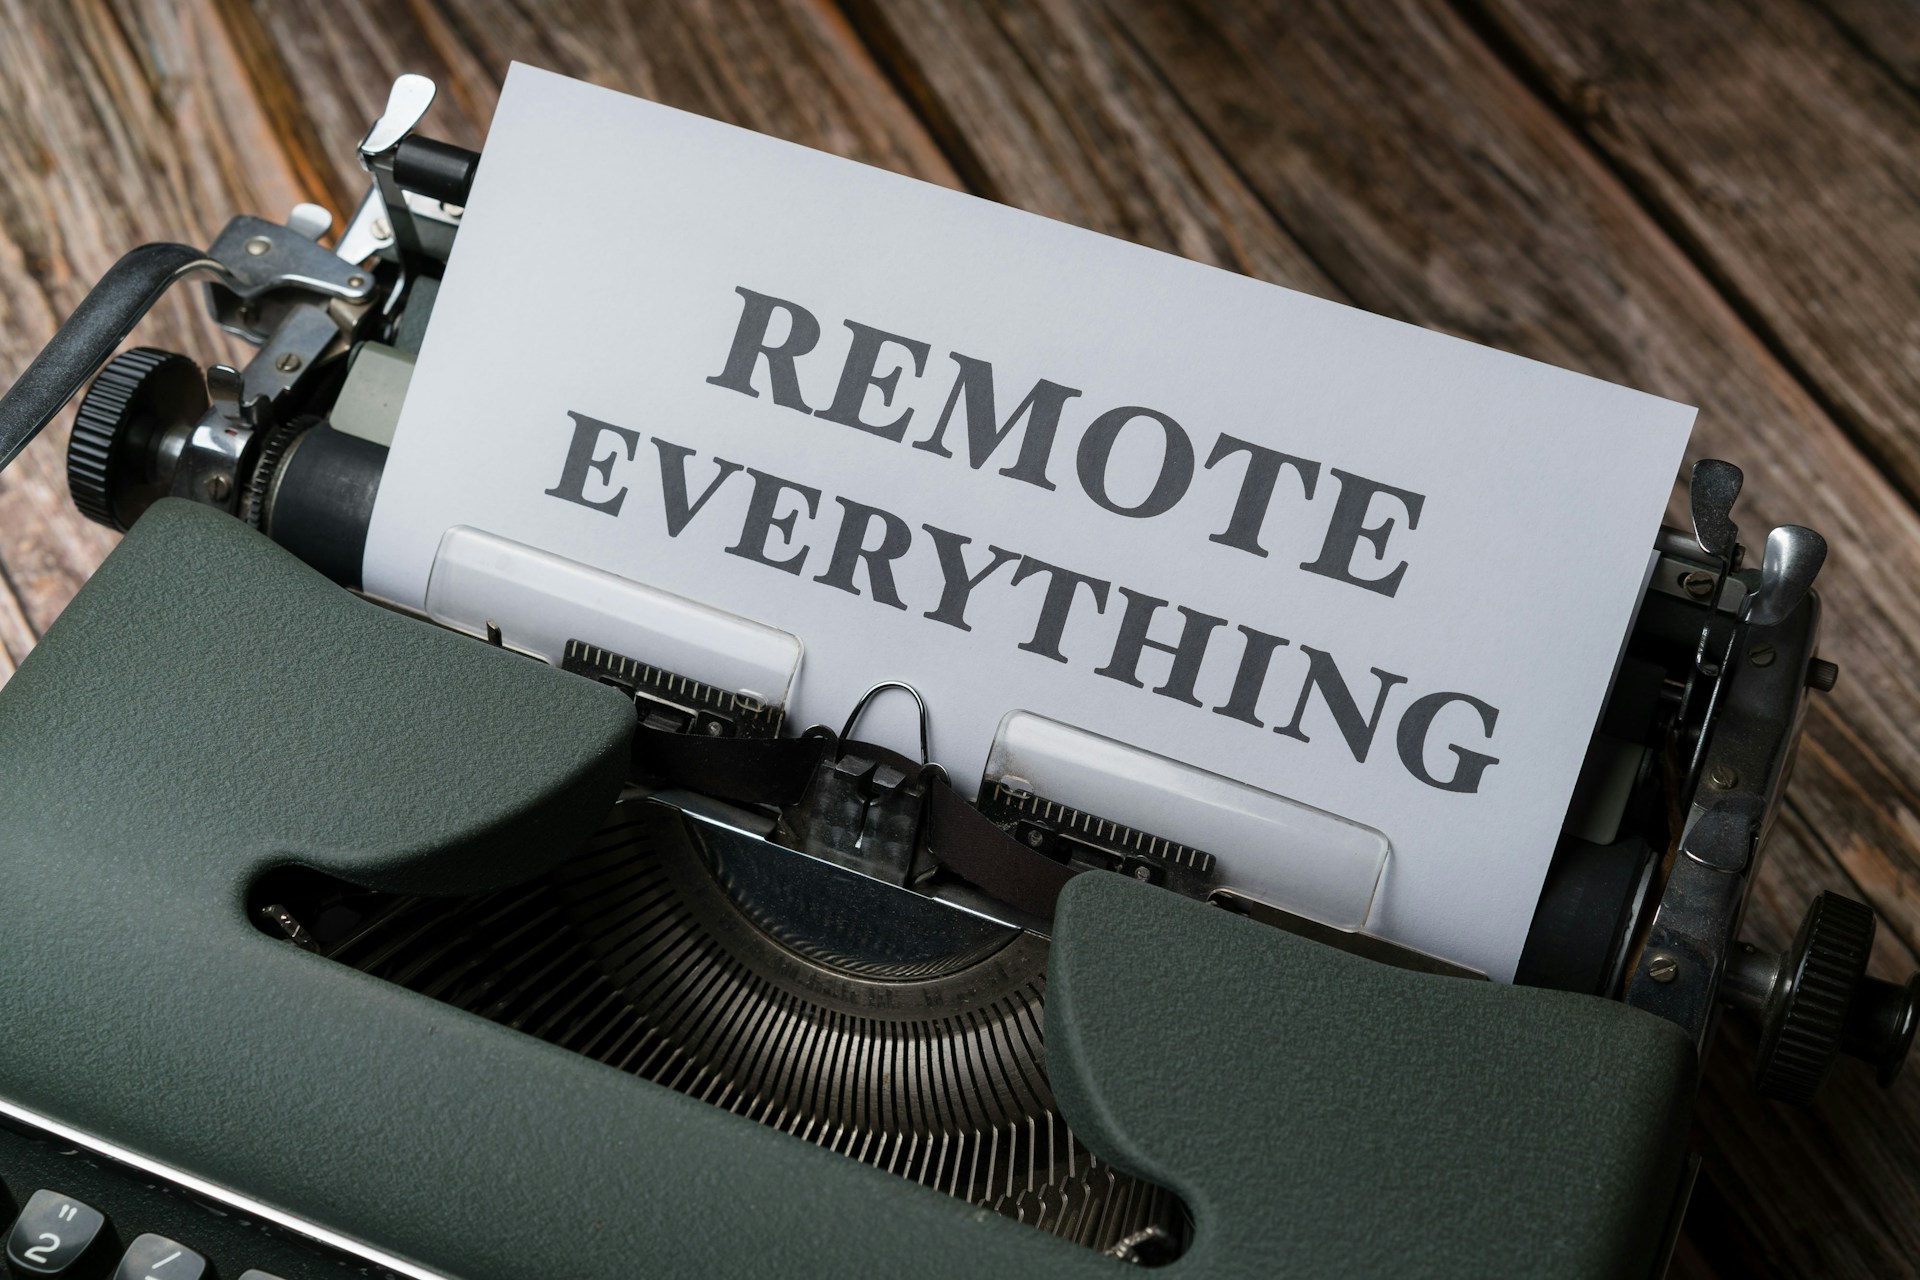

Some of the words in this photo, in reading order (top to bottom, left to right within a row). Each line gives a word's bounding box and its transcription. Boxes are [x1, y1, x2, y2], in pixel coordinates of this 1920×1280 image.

[706, 286, 1426, 598] REMOTE
[545, 411, 1499, 793] EVERYTHING
[25, 1232, 60, 1263] 2
